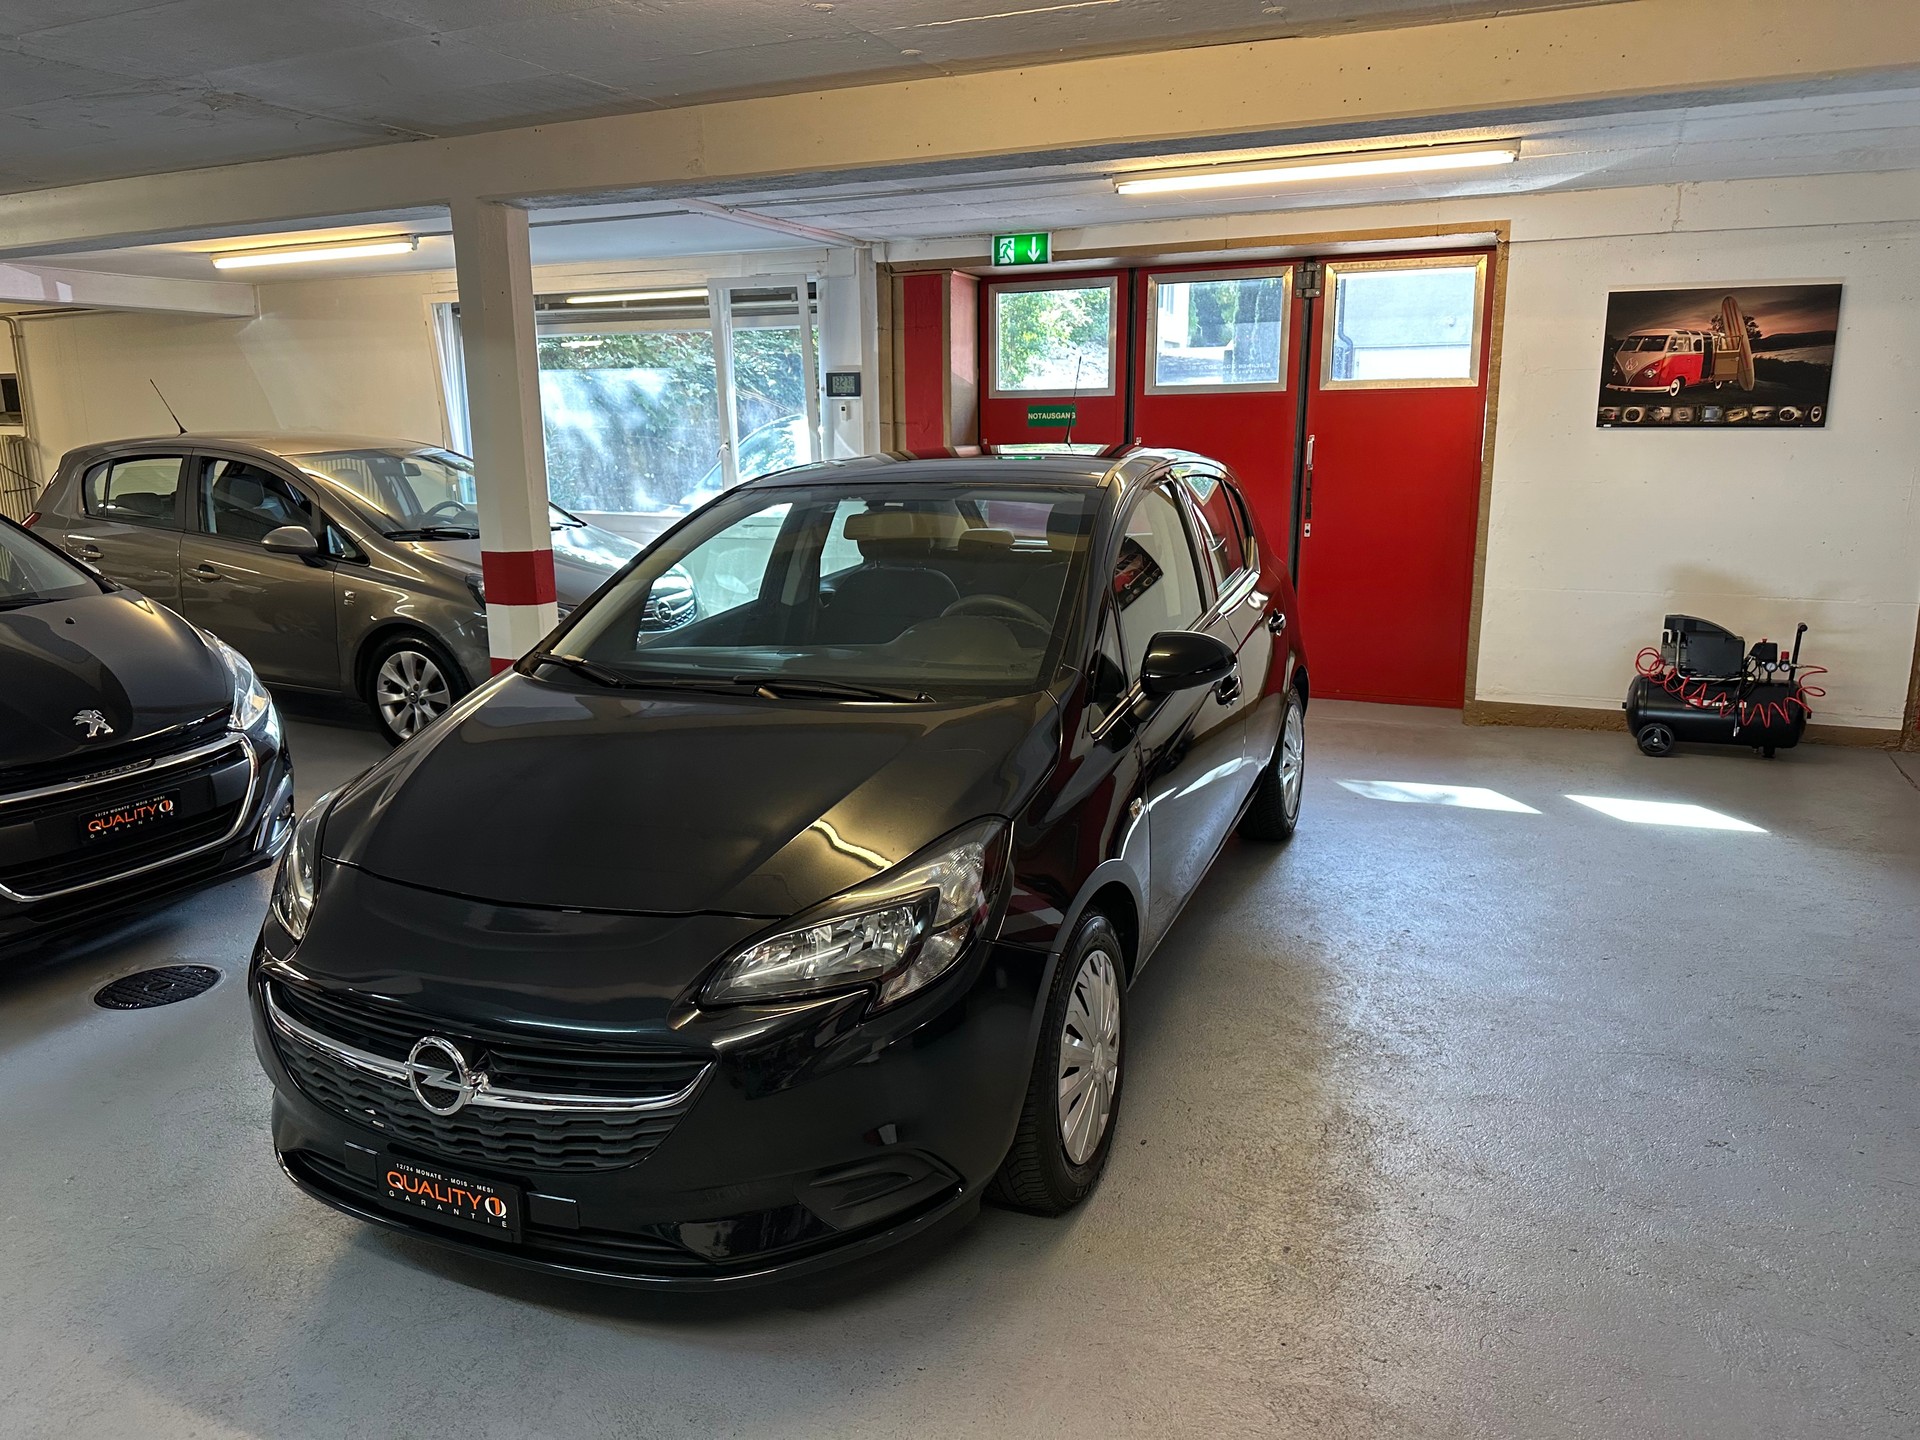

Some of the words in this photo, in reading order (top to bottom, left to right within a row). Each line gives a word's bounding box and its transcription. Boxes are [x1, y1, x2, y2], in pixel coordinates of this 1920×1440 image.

[88, 803, 157, 832] QUALITY
[386, 1171, 482, 1210] QUALITY
[395, 1162, 414, 1172] 12/24
[415, 1167, 442, 1181] MONATE
[450, 1177, 468, 1188] MOIS
[476, 1184, 494, 1194] MESI
[388, 1190, 507, 1228] GARANTIE
